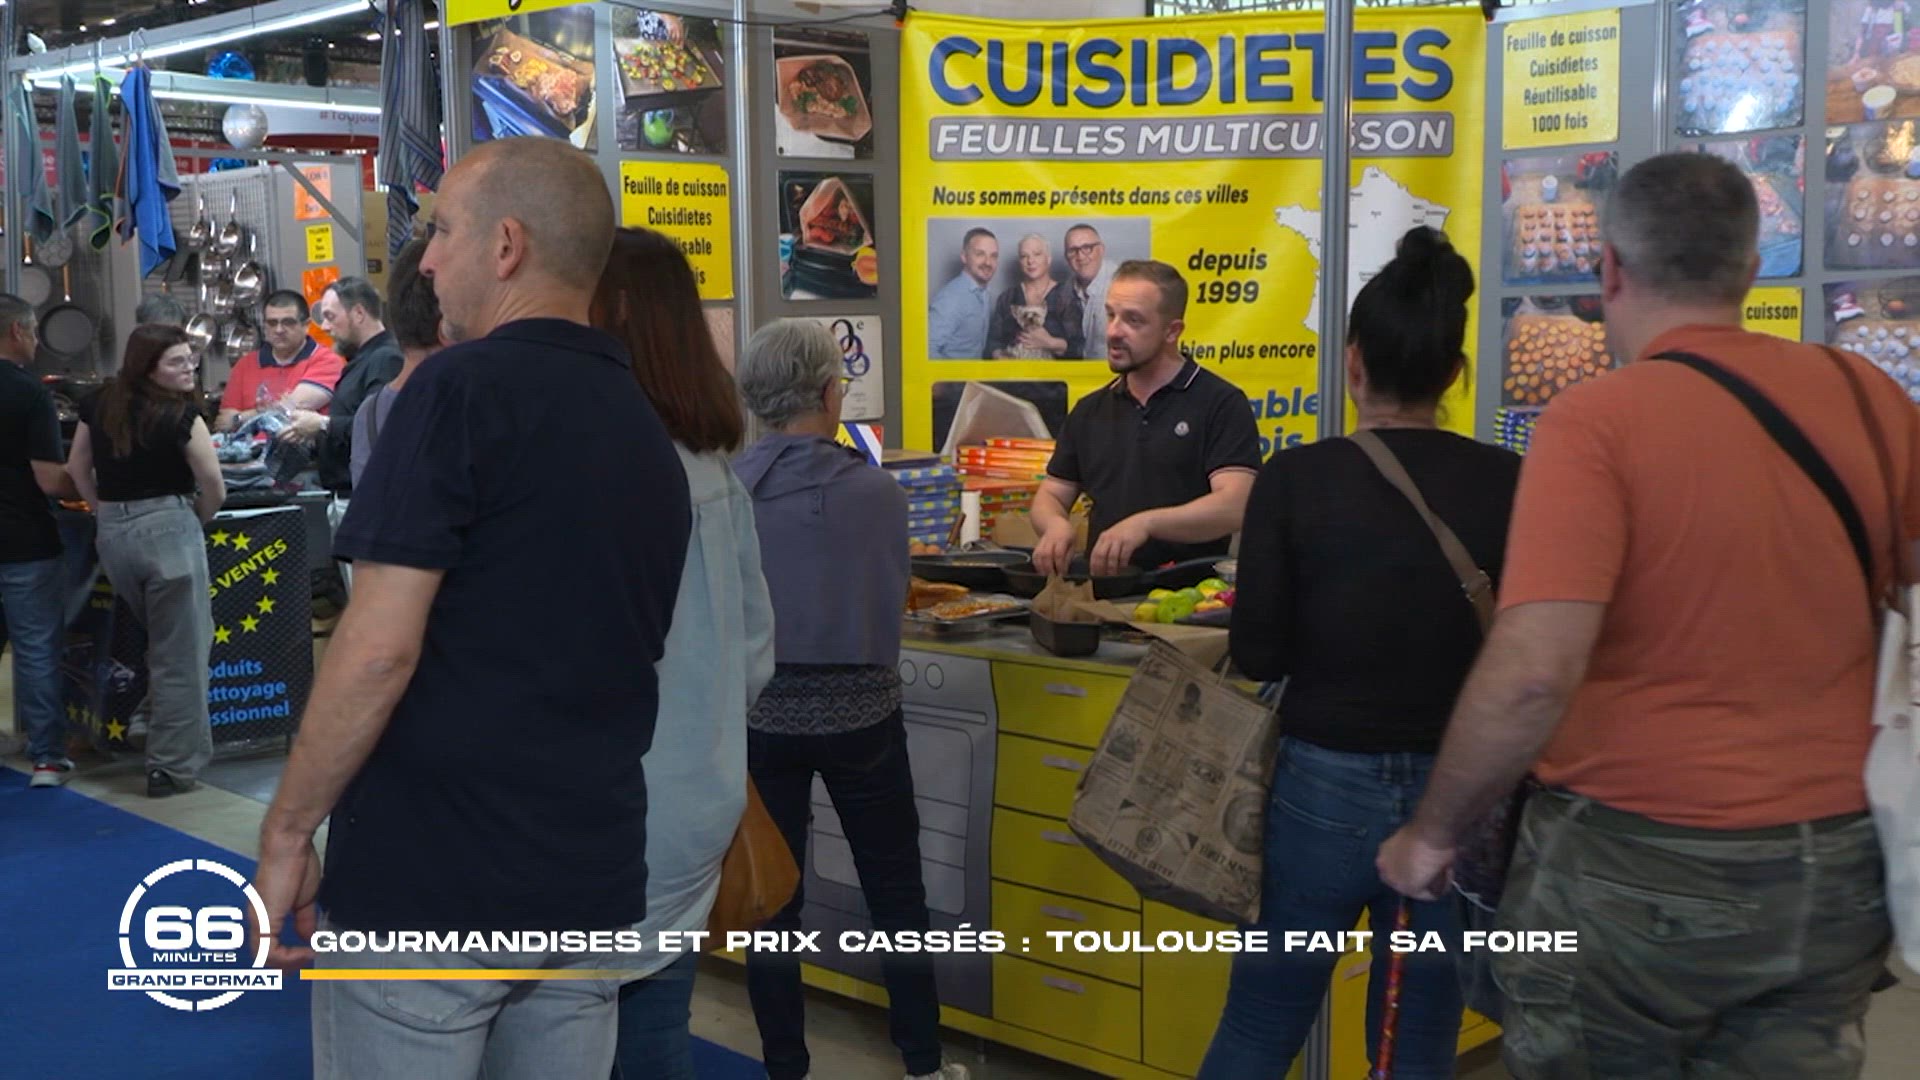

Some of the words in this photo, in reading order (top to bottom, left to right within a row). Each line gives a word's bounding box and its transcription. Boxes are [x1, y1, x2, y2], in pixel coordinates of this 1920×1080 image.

[1506, 31, 1546, 52] Feuille
[1550, 30, 1564, 47] de
[1568, 26, 1617, 45] cuisson
[929, 28, 1454, 109] CUISIDIETES
[1529, 56, 1598, 77] Cuisidietes
[1523, 83, 1597, 106] Réutilisable
[1532, 113, 1561, 133] 1000
[1565, 111, 1588, 130] fois
[936, 123, 1126, 155] FEUILLES
[1136, 119, 1447, 154] MULTICUSON
[623, 175, 662, 195] Feuille
[666, 177, 679, 196] de
[683, 179, 727, 197] cuisson
[932, 185, 974, 205] Nous
[978, 189, 1046, 206] sommes
[1049, 185, 1124, 209] présents
[1129, 186, 1170, 205] dans
[1174, 189, 1201, 205] ces
[1206, 184, 1249, 204] villes
[647, 206, 713, 227] Cuisidietes
[1188, 247, 1268, 276] depuis
[1196, 280, 1260, 304] 1999
[1746, 300, 1798, 320] cuisson
[1219, 340, 1255, 364] plus
[1258, 343, 1316, 359] encore
[216, 538, 288, 588] VENTES
